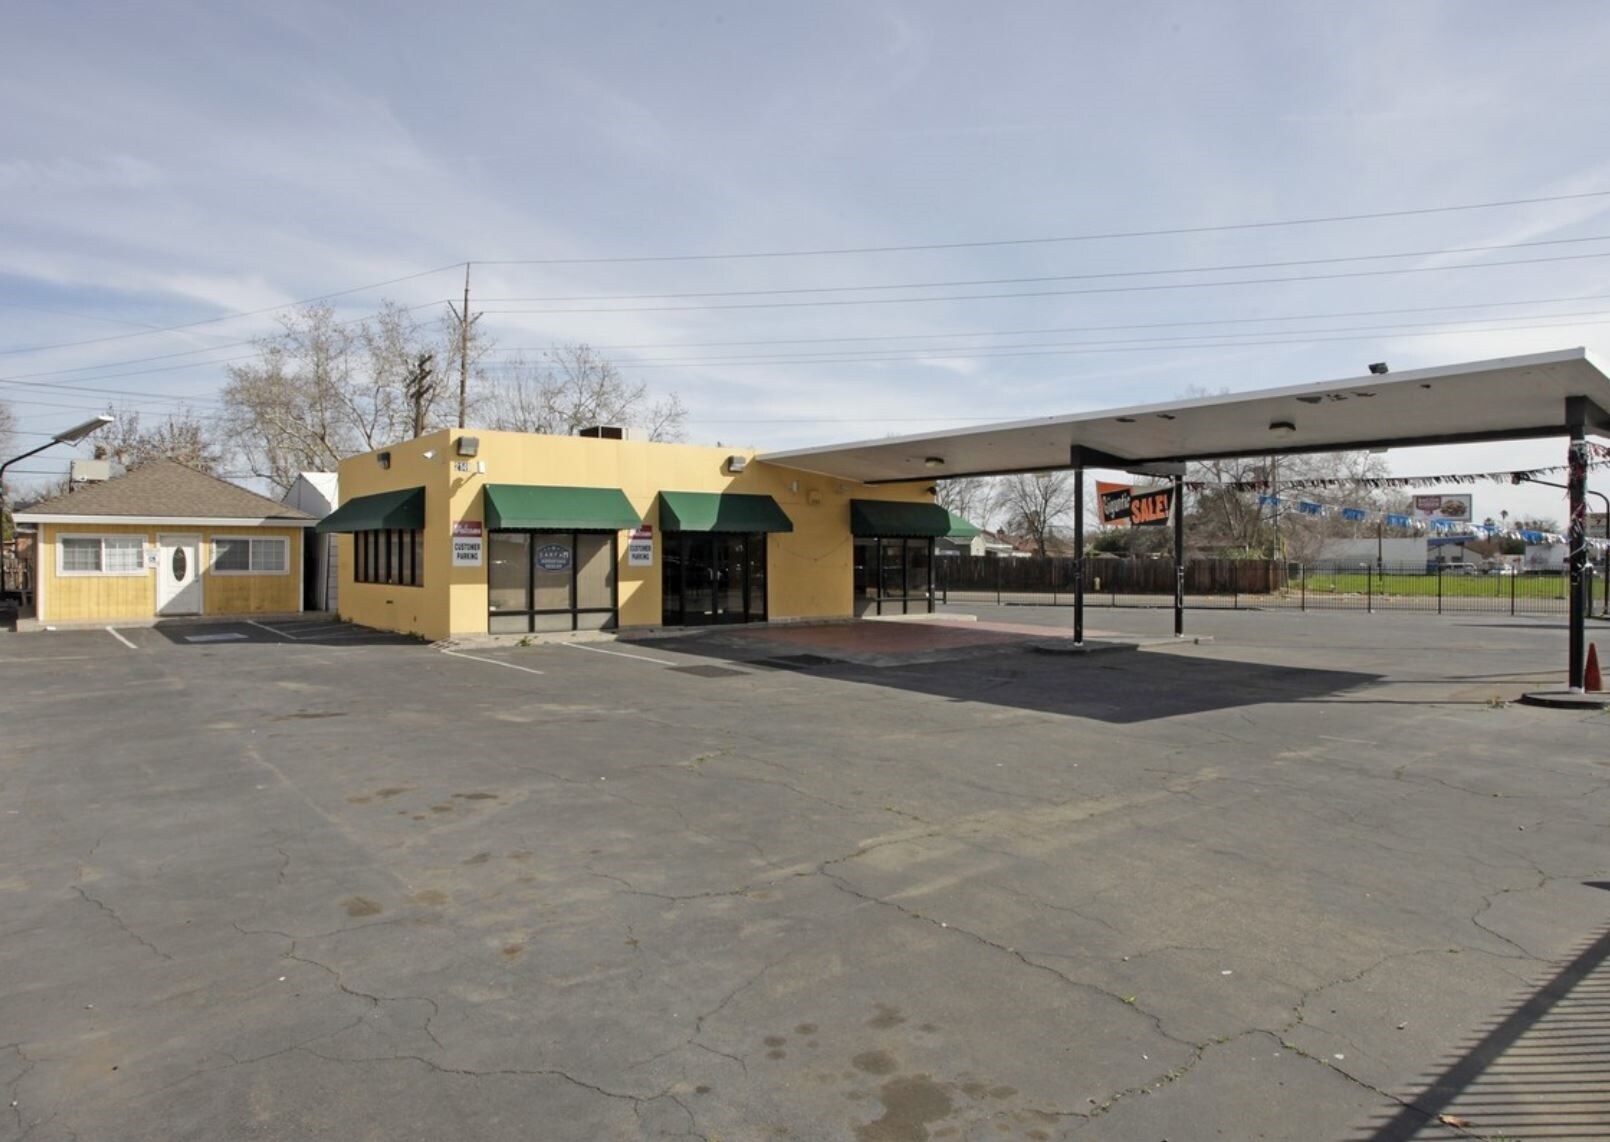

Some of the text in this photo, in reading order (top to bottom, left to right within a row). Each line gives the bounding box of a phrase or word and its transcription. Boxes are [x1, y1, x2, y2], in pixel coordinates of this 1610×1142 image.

[1131, 494, 1169, 524] SALE!
[454, 543, 481, 551] CUSTOMER
[456, 552, 479, 560] PARKING
